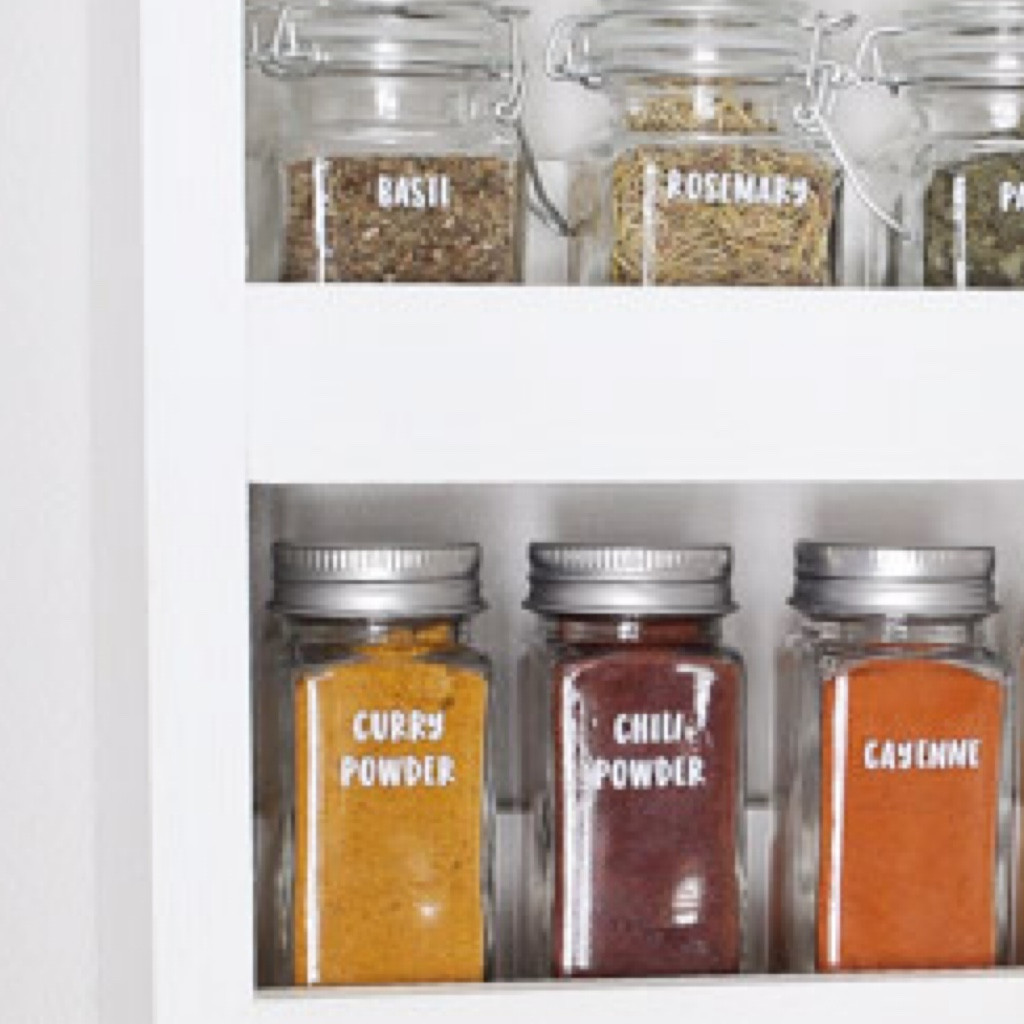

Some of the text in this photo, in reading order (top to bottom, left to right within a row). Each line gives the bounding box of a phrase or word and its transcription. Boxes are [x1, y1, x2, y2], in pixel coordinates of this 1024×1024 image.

[378, 173, 450, 208] BASIL
[667, 170, 809, 207] ROSEMARY
[353, 710, 444, 742] CURRY
[864, 739, 982, 769] CAYENNE
[340, 755, 455, 787] POWDER
[593, 757, 704, 790] POWDER
